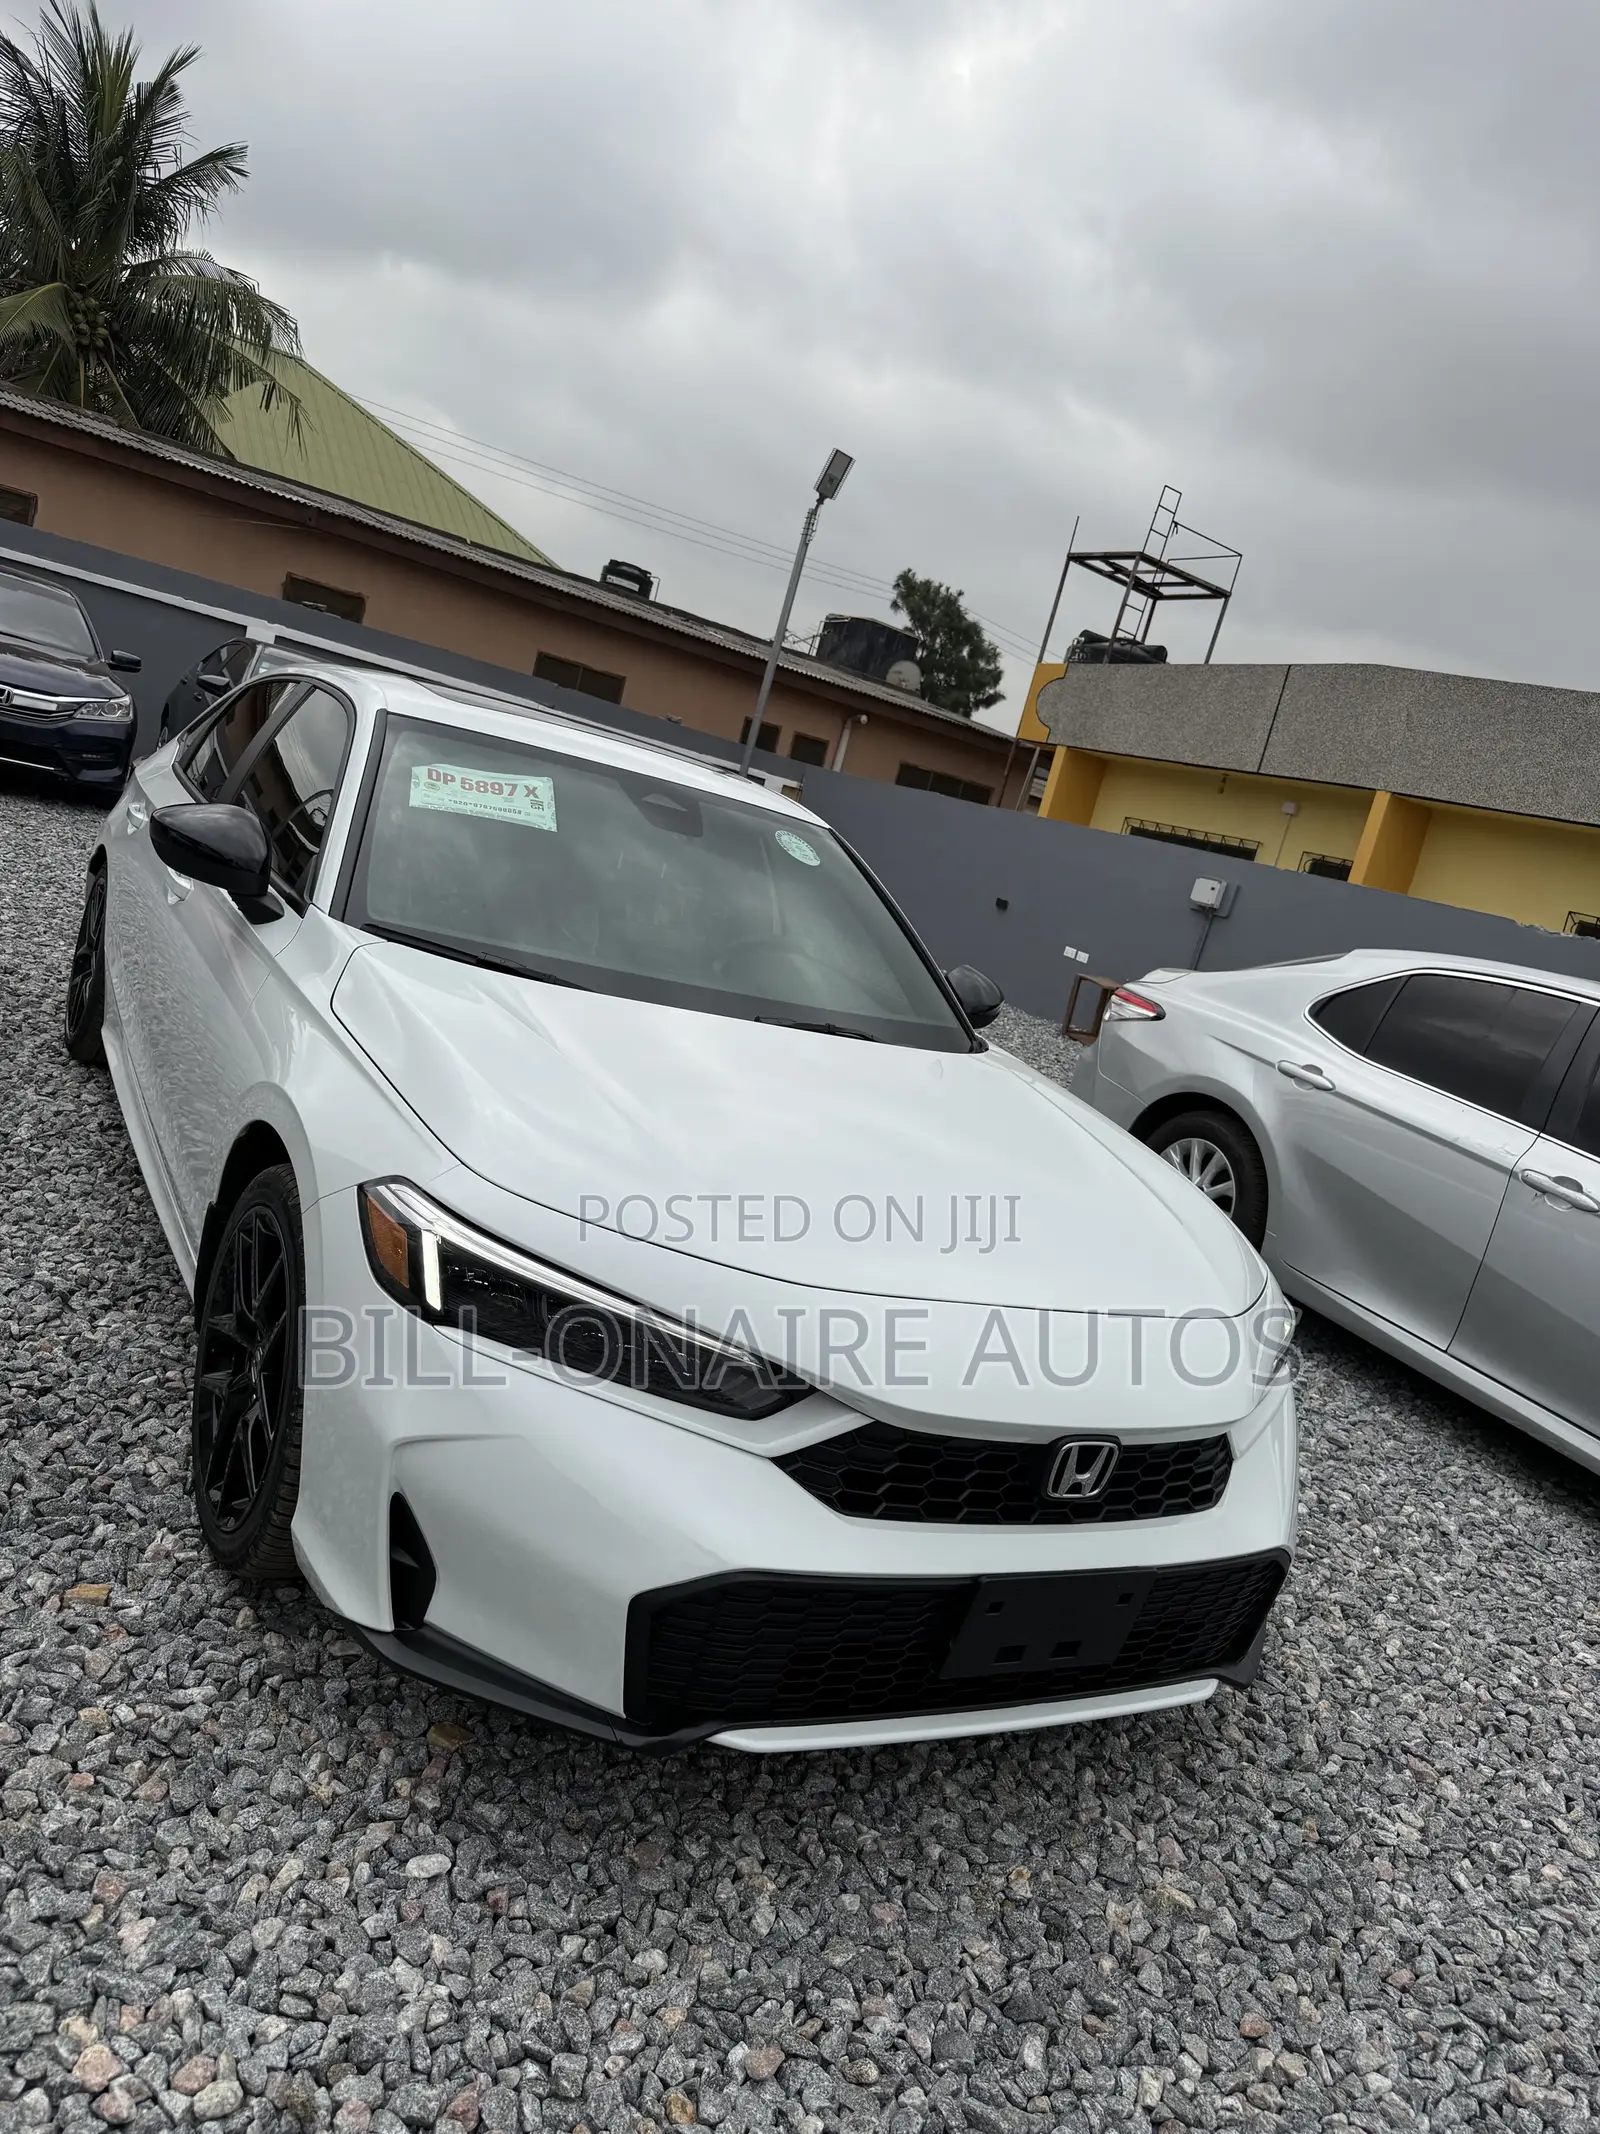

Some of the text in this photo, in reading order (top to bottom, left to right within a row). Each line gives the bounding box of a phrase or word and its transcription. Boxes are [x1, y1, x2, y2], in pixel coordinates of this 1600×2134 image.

[427, 767, 540, 799] DP 5897 X
